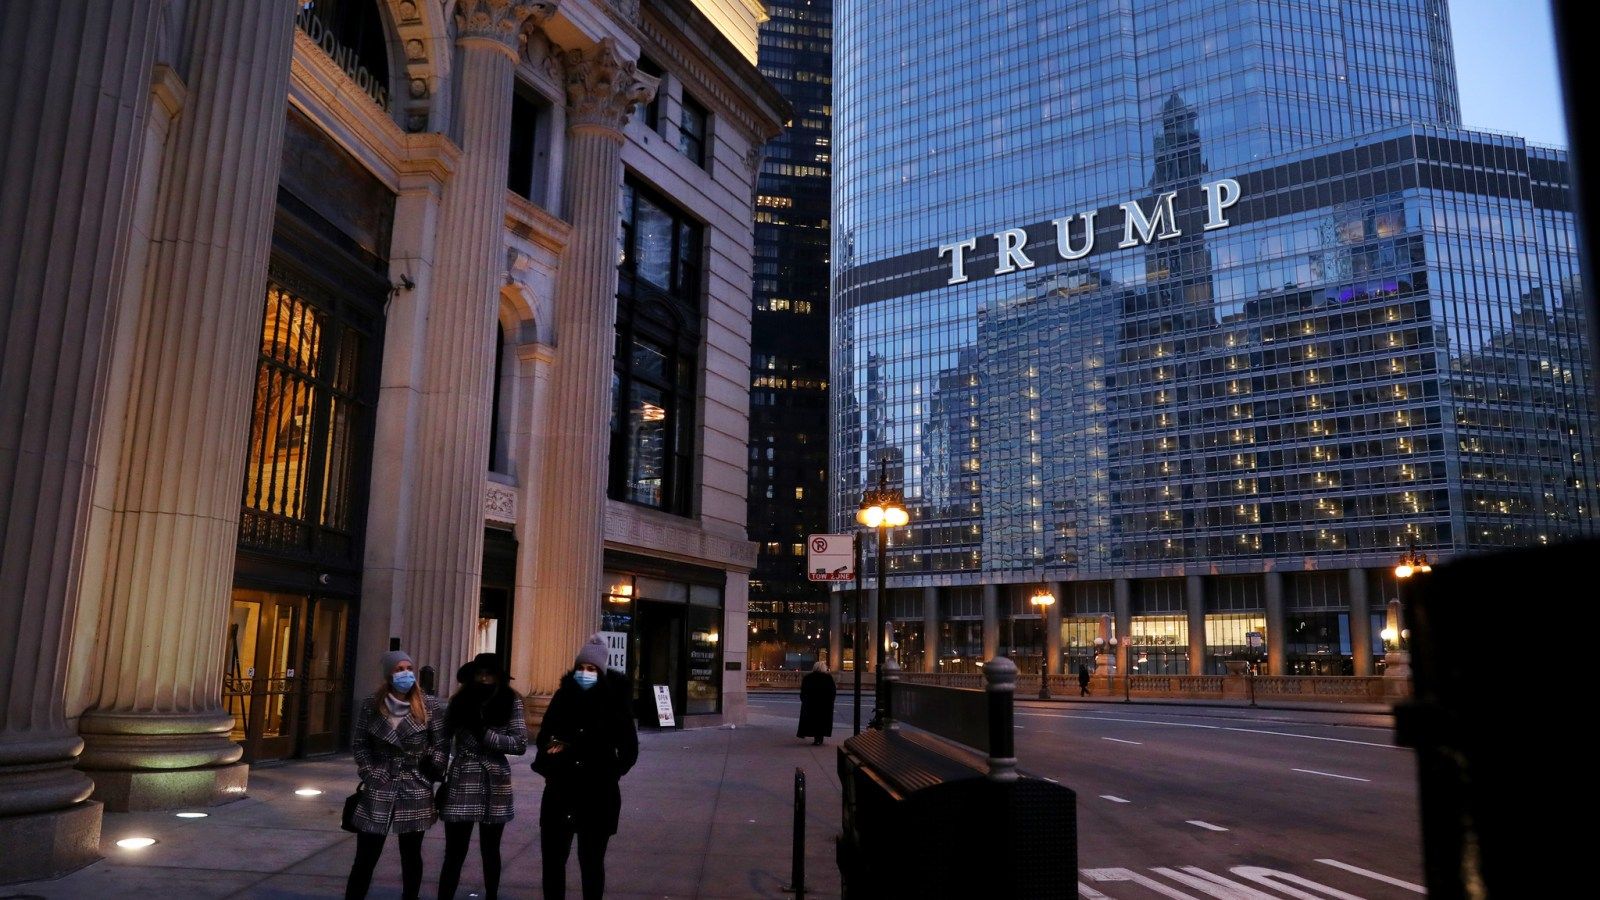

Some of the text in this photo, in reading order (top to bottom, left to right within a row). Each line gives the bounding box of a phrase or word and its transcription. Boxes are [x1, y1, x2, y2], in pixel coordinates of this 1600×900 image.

[299, 10, 388, 111] NDONHOUS
[938, 178, 1241, 285] TRUMP
[607, 637, 624, 649] TAIL
[607, 653, 625, 667] ACE
